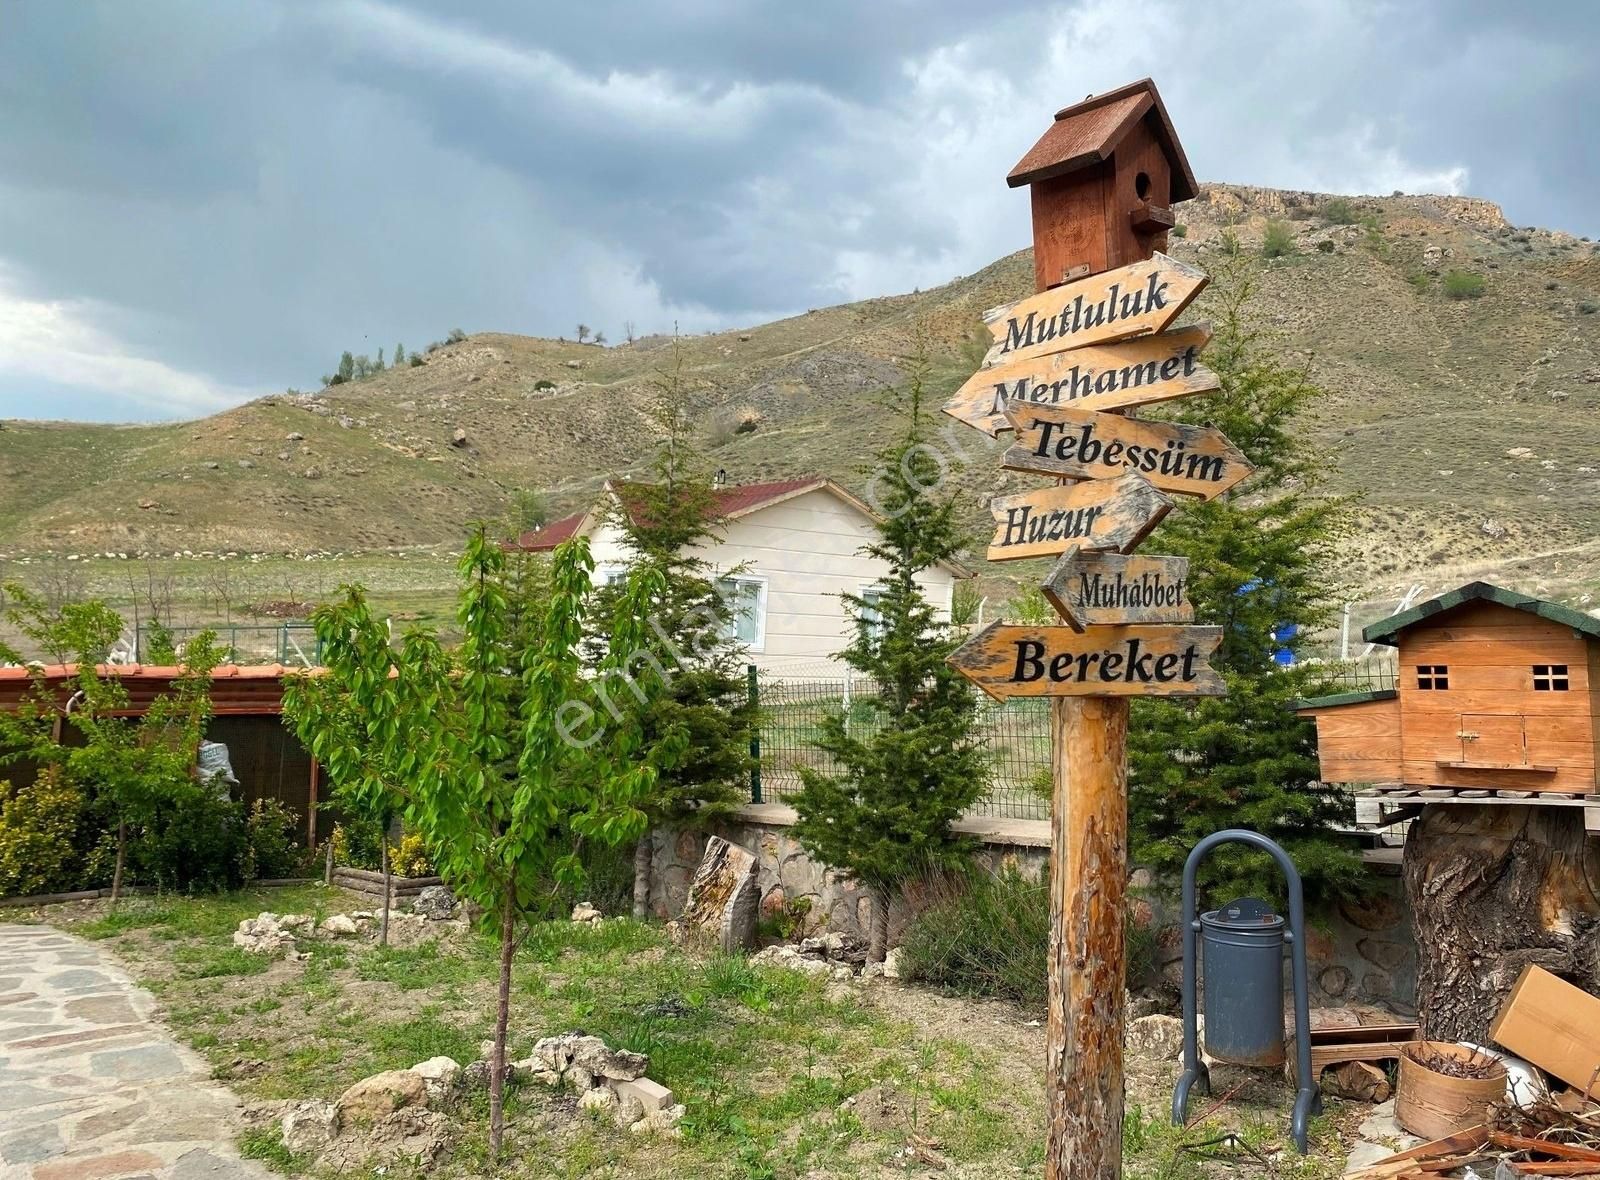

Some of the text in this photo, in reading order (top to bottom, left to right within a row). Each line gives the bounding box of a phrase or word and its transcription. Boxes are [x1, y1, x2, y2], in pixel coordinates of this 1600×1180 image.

[1000, 272, 1168, 354] Mutluluk
[989, 346, 1197, 416] Merhamet
[1032, 418, 1223, 481] Tebessüm
[1001, 505, 1103, 547] Huzur
[1077, 571, 1185, 608] Muhabbet
[1008, 638, 1199, 683] Bereket
